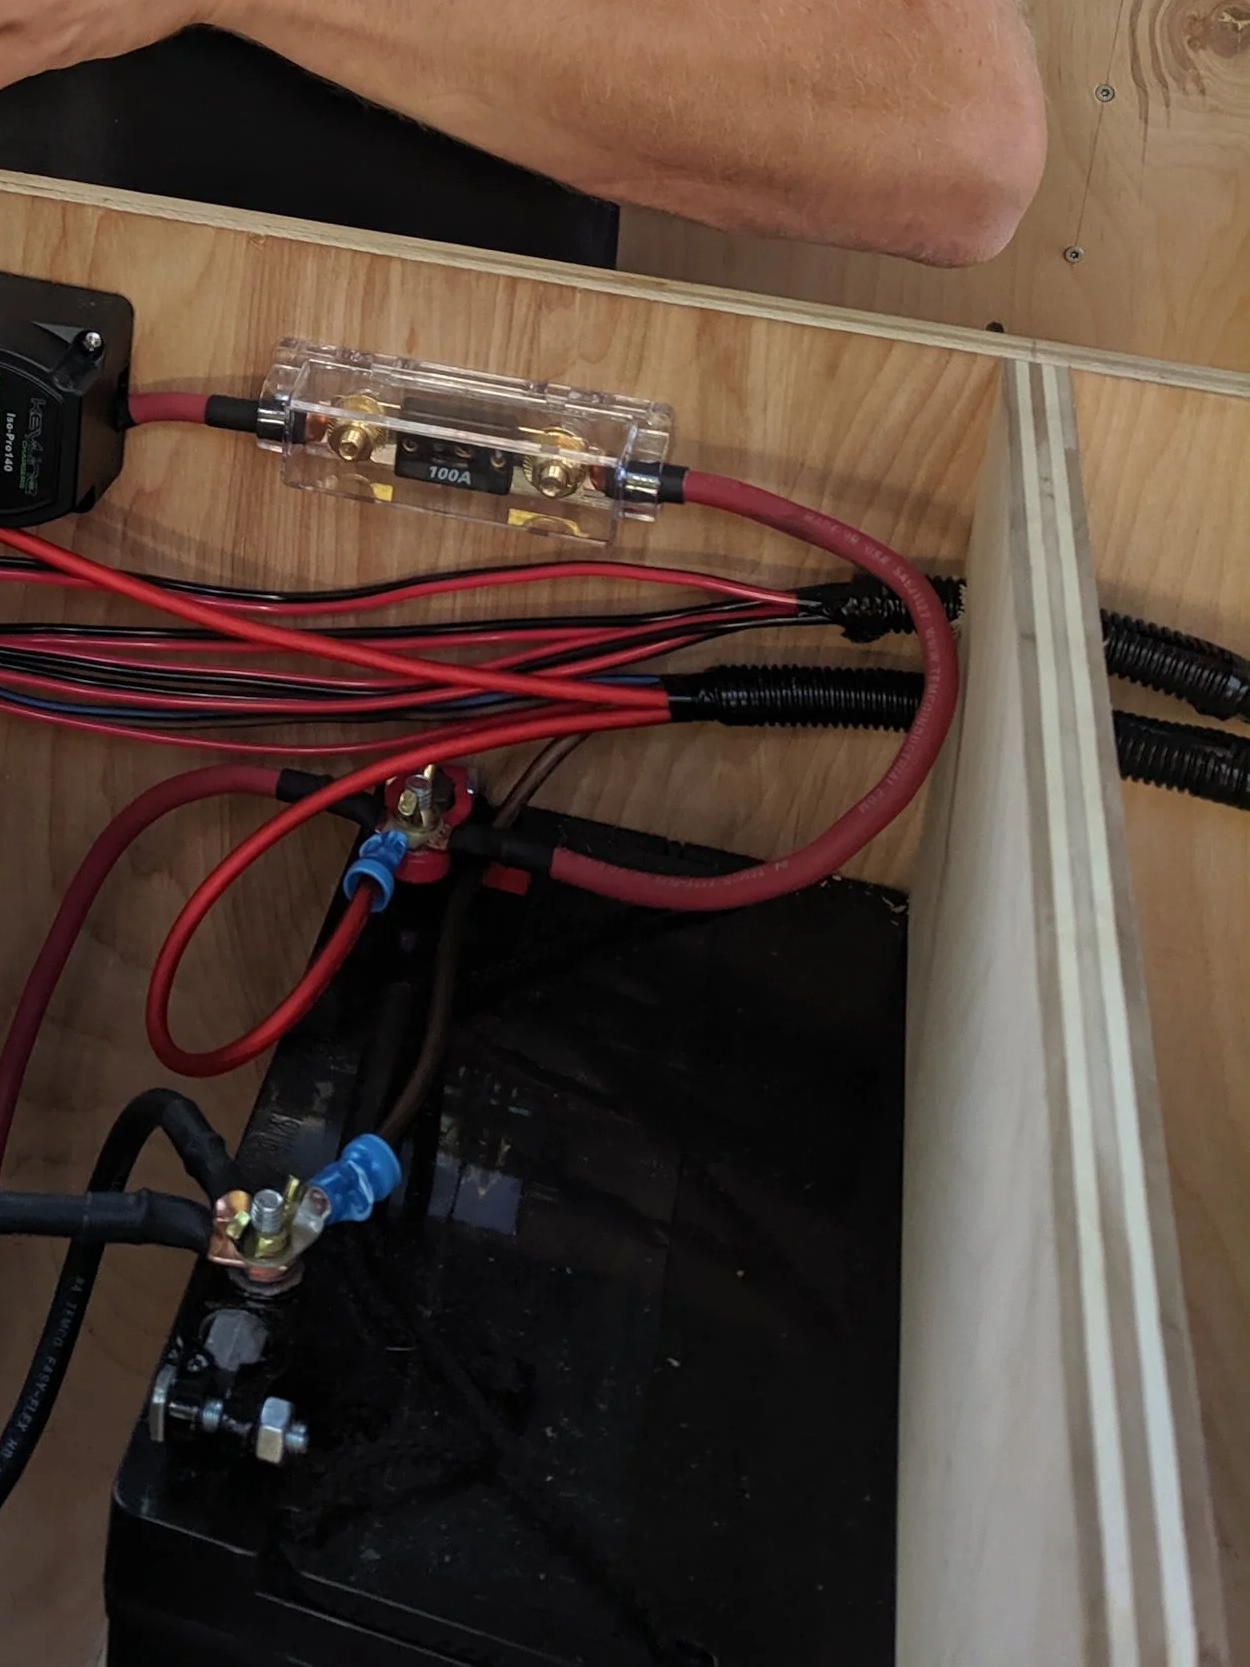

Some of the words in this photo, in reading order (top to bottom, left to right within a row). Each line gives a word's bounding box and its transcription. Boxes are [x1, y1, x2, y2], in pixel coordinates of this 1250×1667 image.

[3, 412, 17, 472] Iso-Pro140
[429, 466, 471, 485] 100A
[0, 1437, 18, 1459] HD
